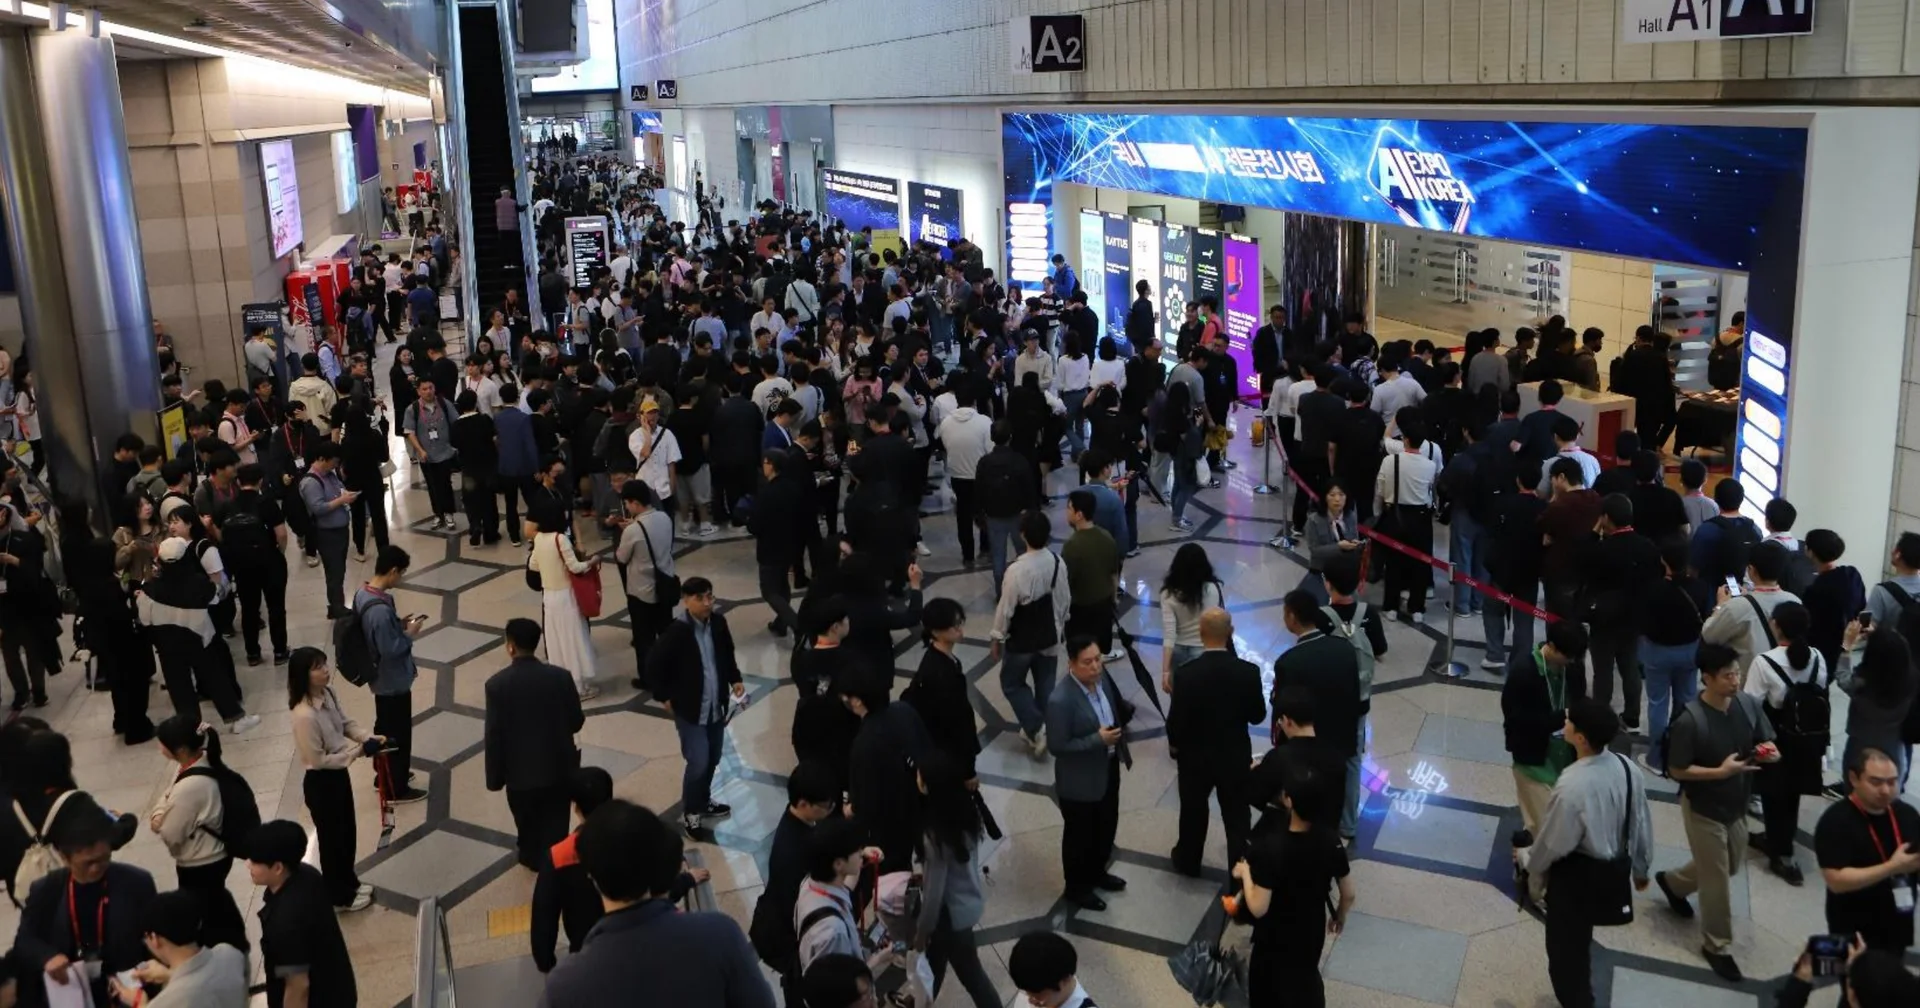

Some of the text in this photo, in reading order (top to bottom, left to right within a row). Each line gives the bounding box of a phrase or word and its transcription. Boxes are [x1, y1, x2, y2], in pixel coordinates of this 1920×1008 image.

[1638, 18, 1663, 33] Hall
[1034, 24, 1082, 65] A2
[632, 87, 647, 100] A4
[659, 83, 677, 98] A3
[1220, 147, 1326, 184] 전문전시회
[1378, 147, 1424, 201] AI
[1404, 150, 1451, 176] EXPO
[1415, 177, 1476, 204] KOREA
